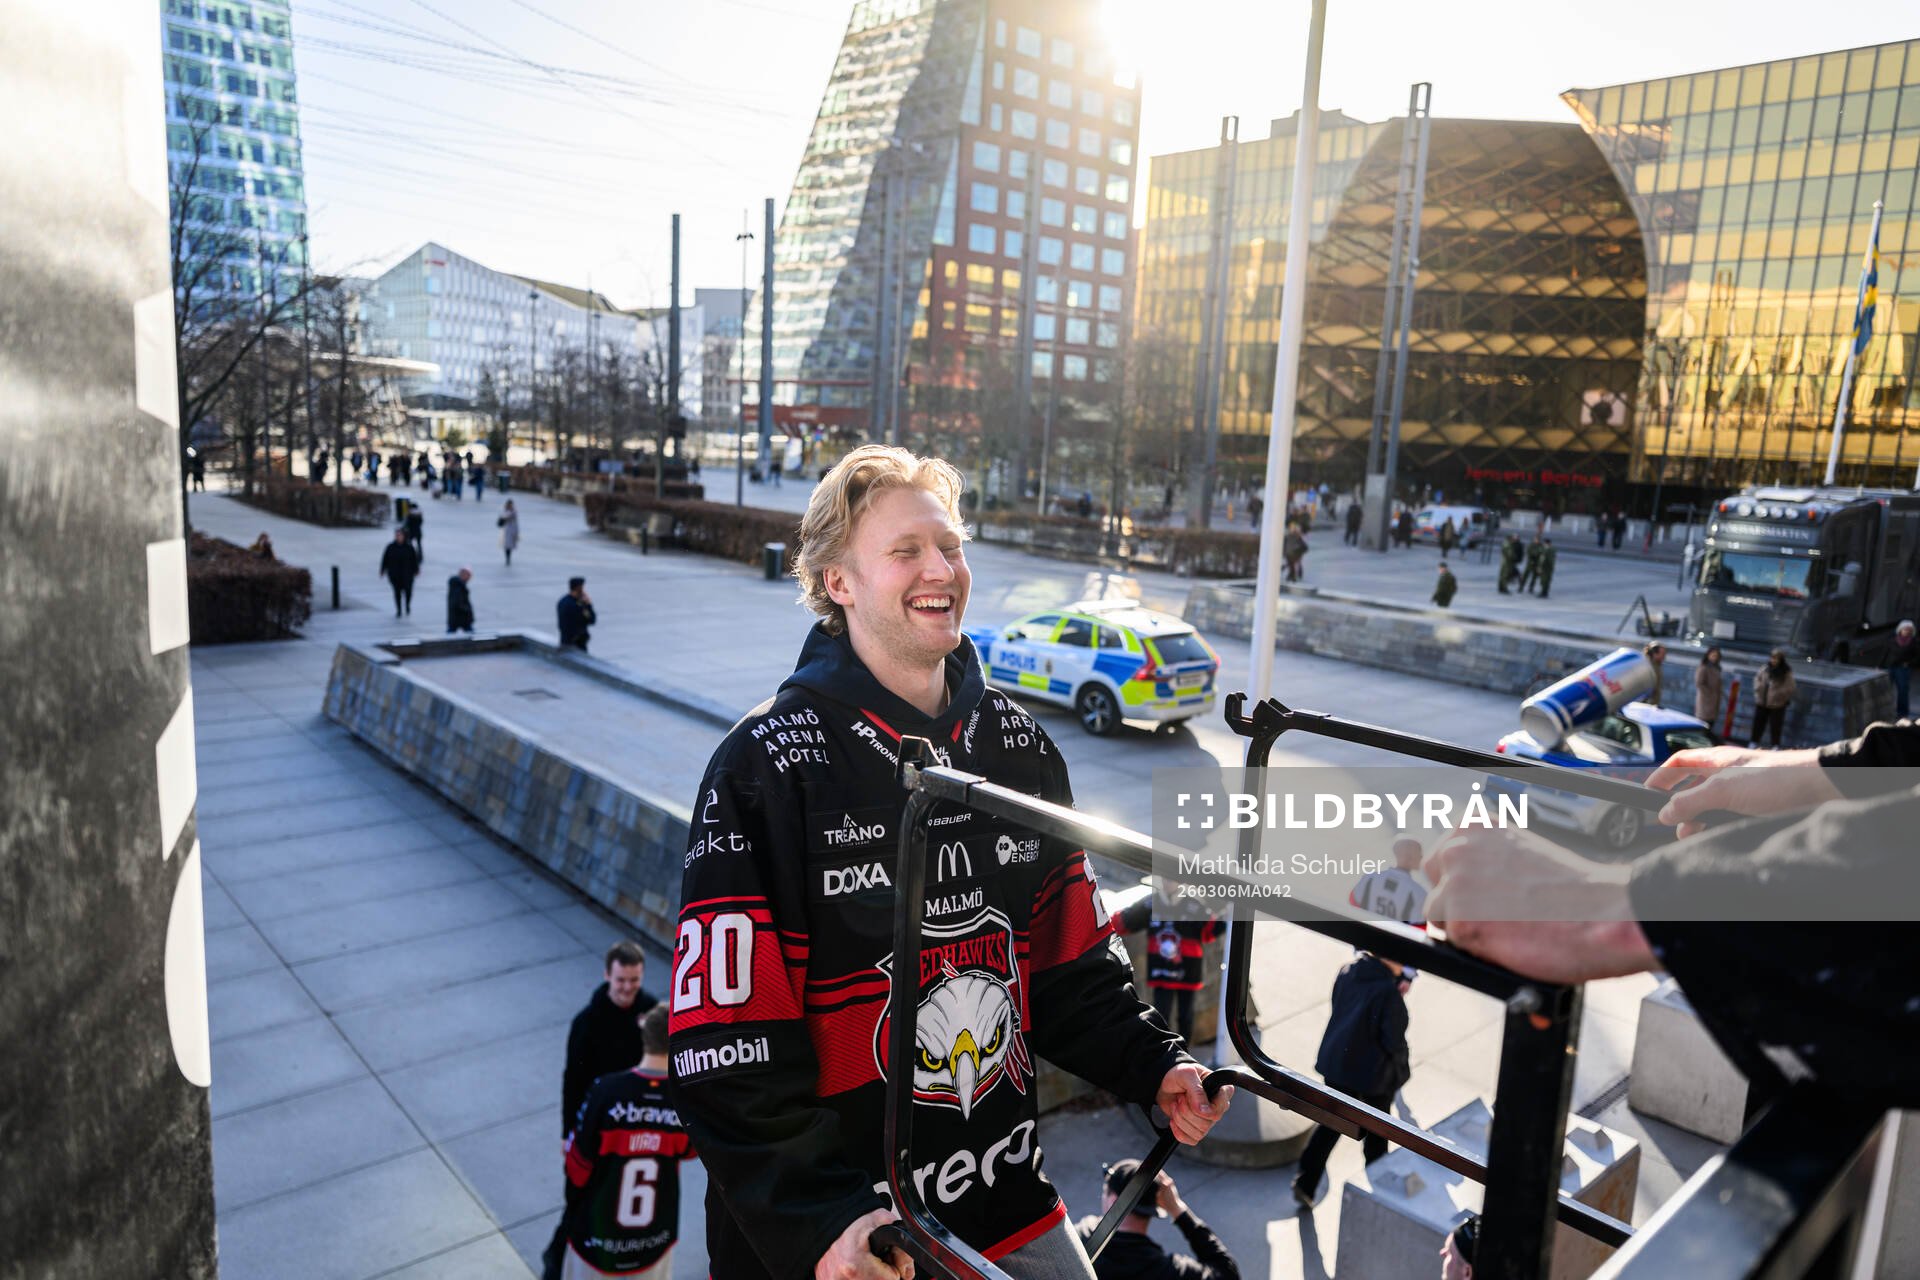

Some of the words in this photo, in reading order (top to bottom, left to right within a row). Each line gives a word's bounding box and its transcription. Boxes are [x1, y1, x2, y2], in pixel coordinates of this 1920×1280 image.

[1000, 650, 1036, 671] POLIS
[750, 710, 820, 740] MALMÖ
[765, 730, 826, 756] ARENA
[774, 747, 830, 773] HOTEL
[823, 862, 892, 896] DOXA
[925, 886, 983, 917] MALMÖ
[673, 913, 753, 1013] 20
[919, 930, 1008, 987] EDHAWKS
[674, 1037, 770, 1078] tillmobil
[616, 1157, 659, 1227] 6
